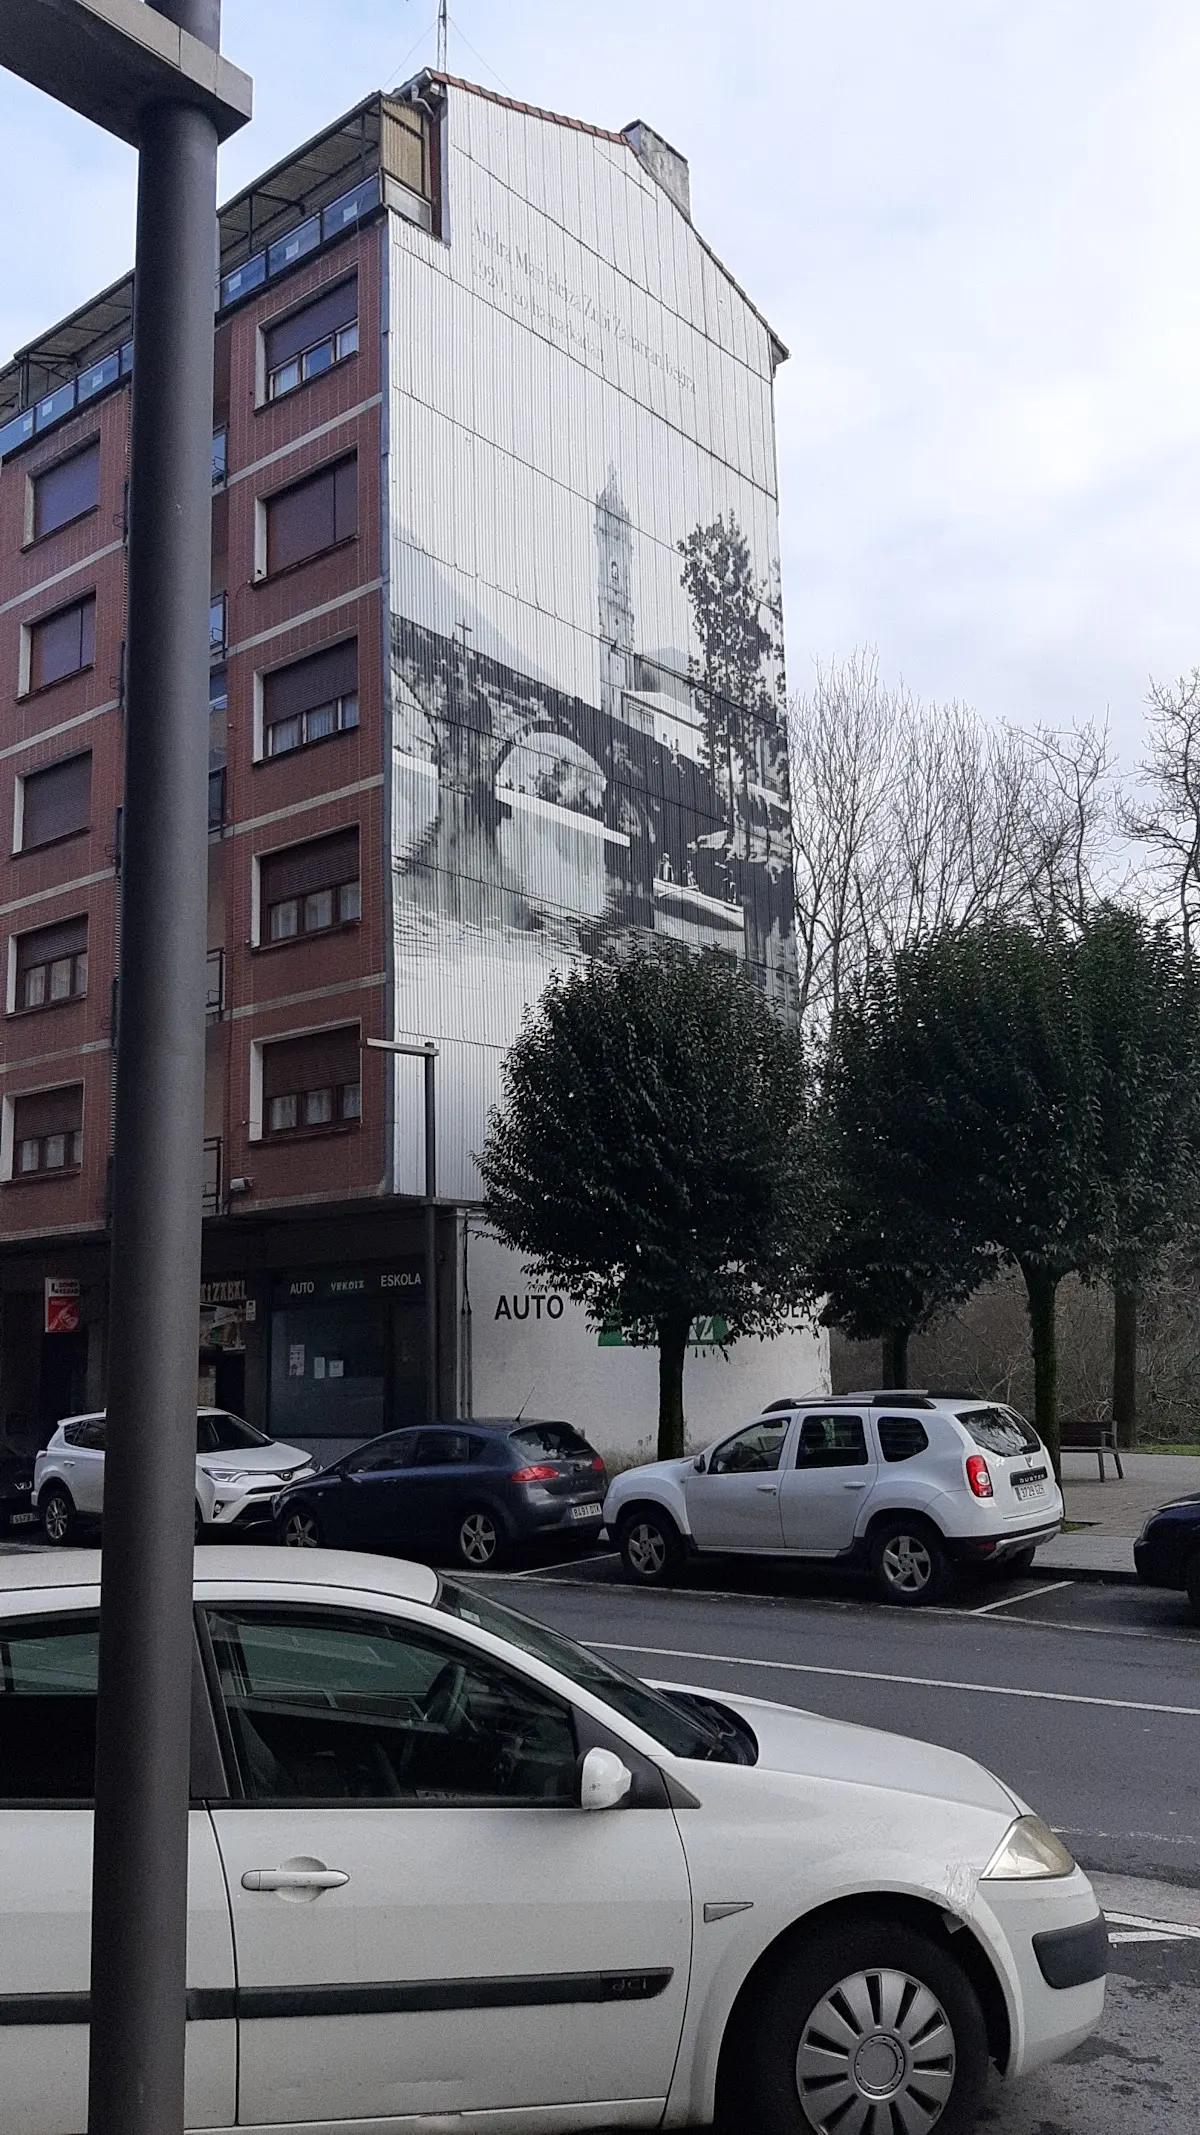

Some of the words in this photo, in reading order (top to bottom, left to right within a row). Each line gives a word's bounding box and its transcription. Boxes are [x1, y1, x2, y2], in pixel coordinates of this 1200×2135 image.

[290, 1281, 315, 1294] AUTO
[380, 1273, 422, 1287] ESKOLA
[494, 1294, 564, 1320] AUTO
